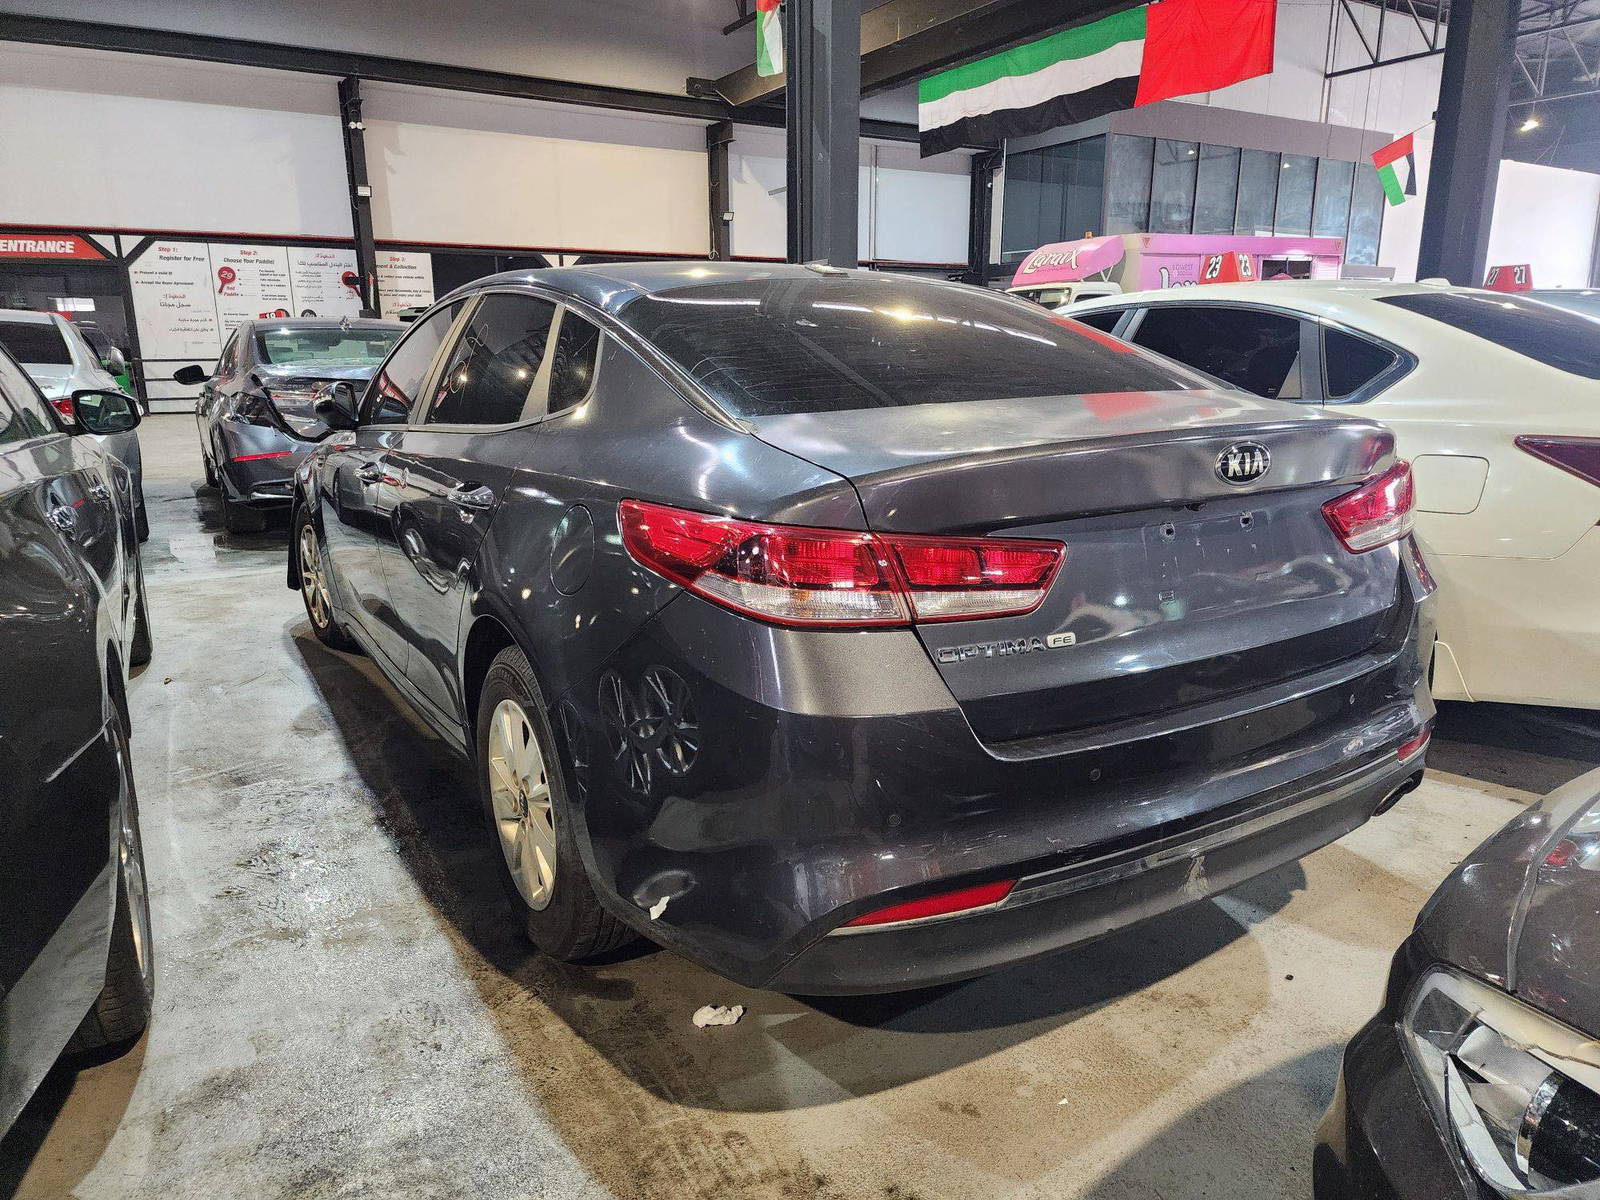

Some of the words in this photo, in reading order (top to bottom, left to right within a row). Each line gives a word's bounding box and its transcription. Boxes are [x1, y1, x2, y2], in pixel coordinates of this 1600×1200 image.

[0, 240, 75, 253] ENTRANCE
[221, 270, 233, 280] 29
[1206, 255, 1222, 279] 23
[1238, 254, 1253, 277] 23
[1514, 265, 1526, 284] 27
[1488, 267, 1500, 286] 27
[1227, 451, 1264, 477] KIA
[936, 636, 1047, 663] OPTIMA
[1052, 636, 1073, 645] FE
